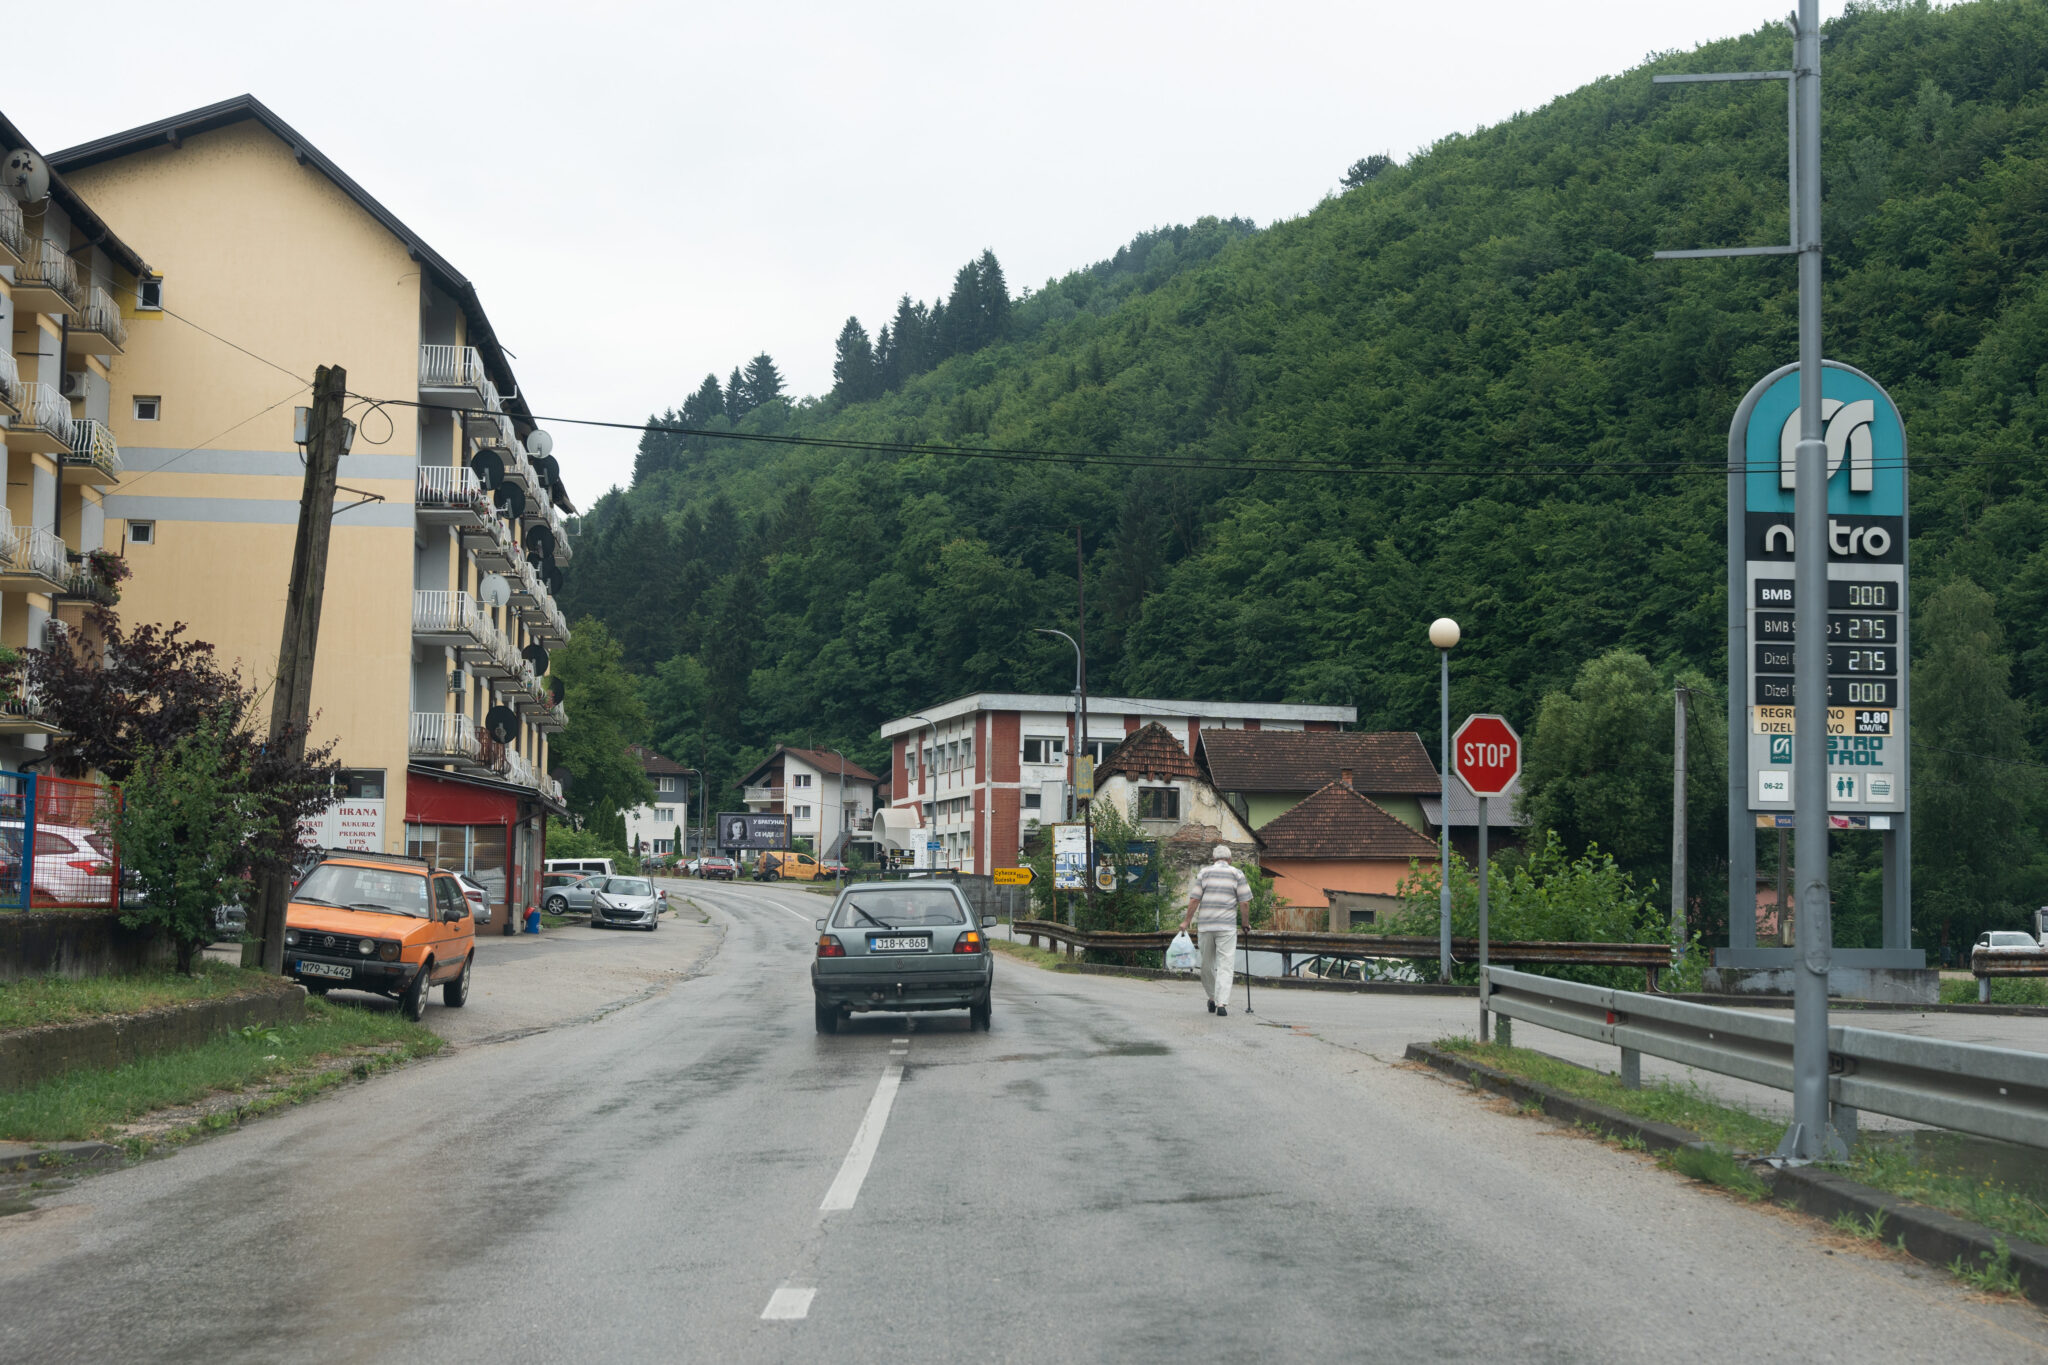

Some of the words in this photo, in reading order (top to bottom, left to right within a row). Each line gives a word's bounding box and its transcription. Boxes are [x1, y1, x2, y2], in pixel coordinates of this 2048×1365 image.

[1765, 519, 1892, 556] ntro
[1762, 589, 1792, 600] BMB
[1849, 586, 1885, 605] 000
[1764, 620, 1790, 632] BMB
[1834, 622, 1841, 634] 5
[1848, 619, 1886, 638] 275
[1764, 652, 1789, 665] Dizel
[1848, 651, 1886, 671] 275
[1764, 684, 1789, 697] Dizel
[1848, 683, 1886, 702] 000
[1760, 707, 1845, 720] REGRNO
[1856, 711, 1888, 724] -0.80
[1760, 722, 1793, 733] DIZEL
[1827, 736, 1883, 750] STRO
[1464, 742, 1511, 768] STOP
[1827, 750, 1883, 766] TROL
[1763, 782, 1784, 790] 06-22
[339, 807, 378, 816] HRANA
[877, 938, 927, 949] J18-K-868
[302, 962, 351, 978] M79-J-442
